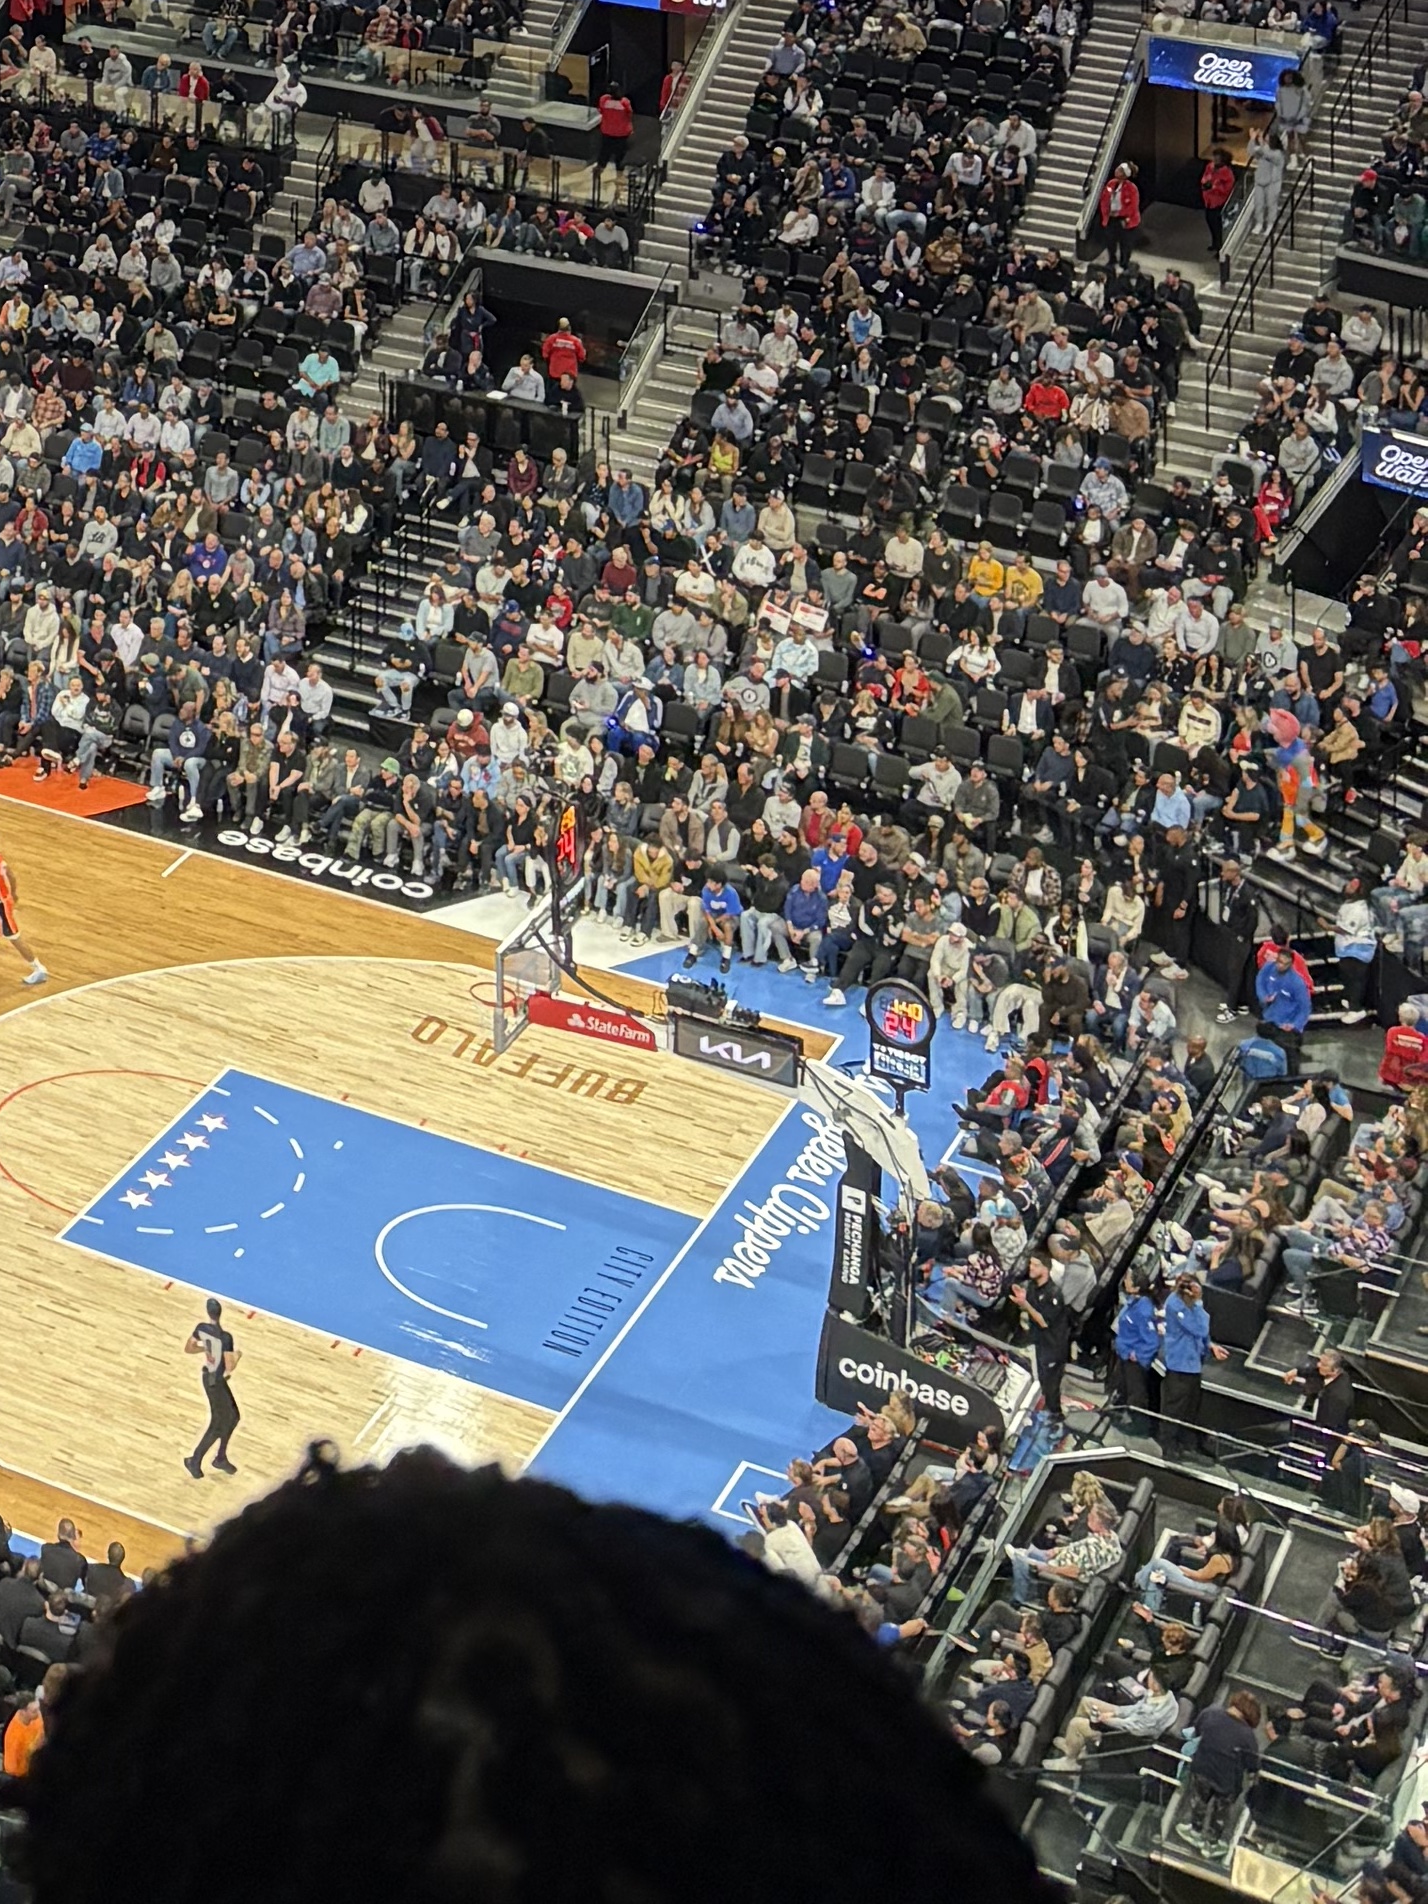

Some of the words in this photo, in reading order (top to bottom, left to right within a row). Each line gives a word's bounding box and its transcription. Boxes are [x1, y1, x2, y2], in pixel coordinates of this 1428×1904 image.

[1194, 69, 1254, 89] Water
[1199, 53, 1252, 73] Open
[216, 826, 435, 901] coinbase
[411, 1016, 648, 1104] BUFFALO
[597, 1246, 654, 1289] CITY
[712, 1183, 831, 1290] Clippers
[542, 1288, 622, 1358] EDITION
[838, 1356, 969, 1417] coinbase
